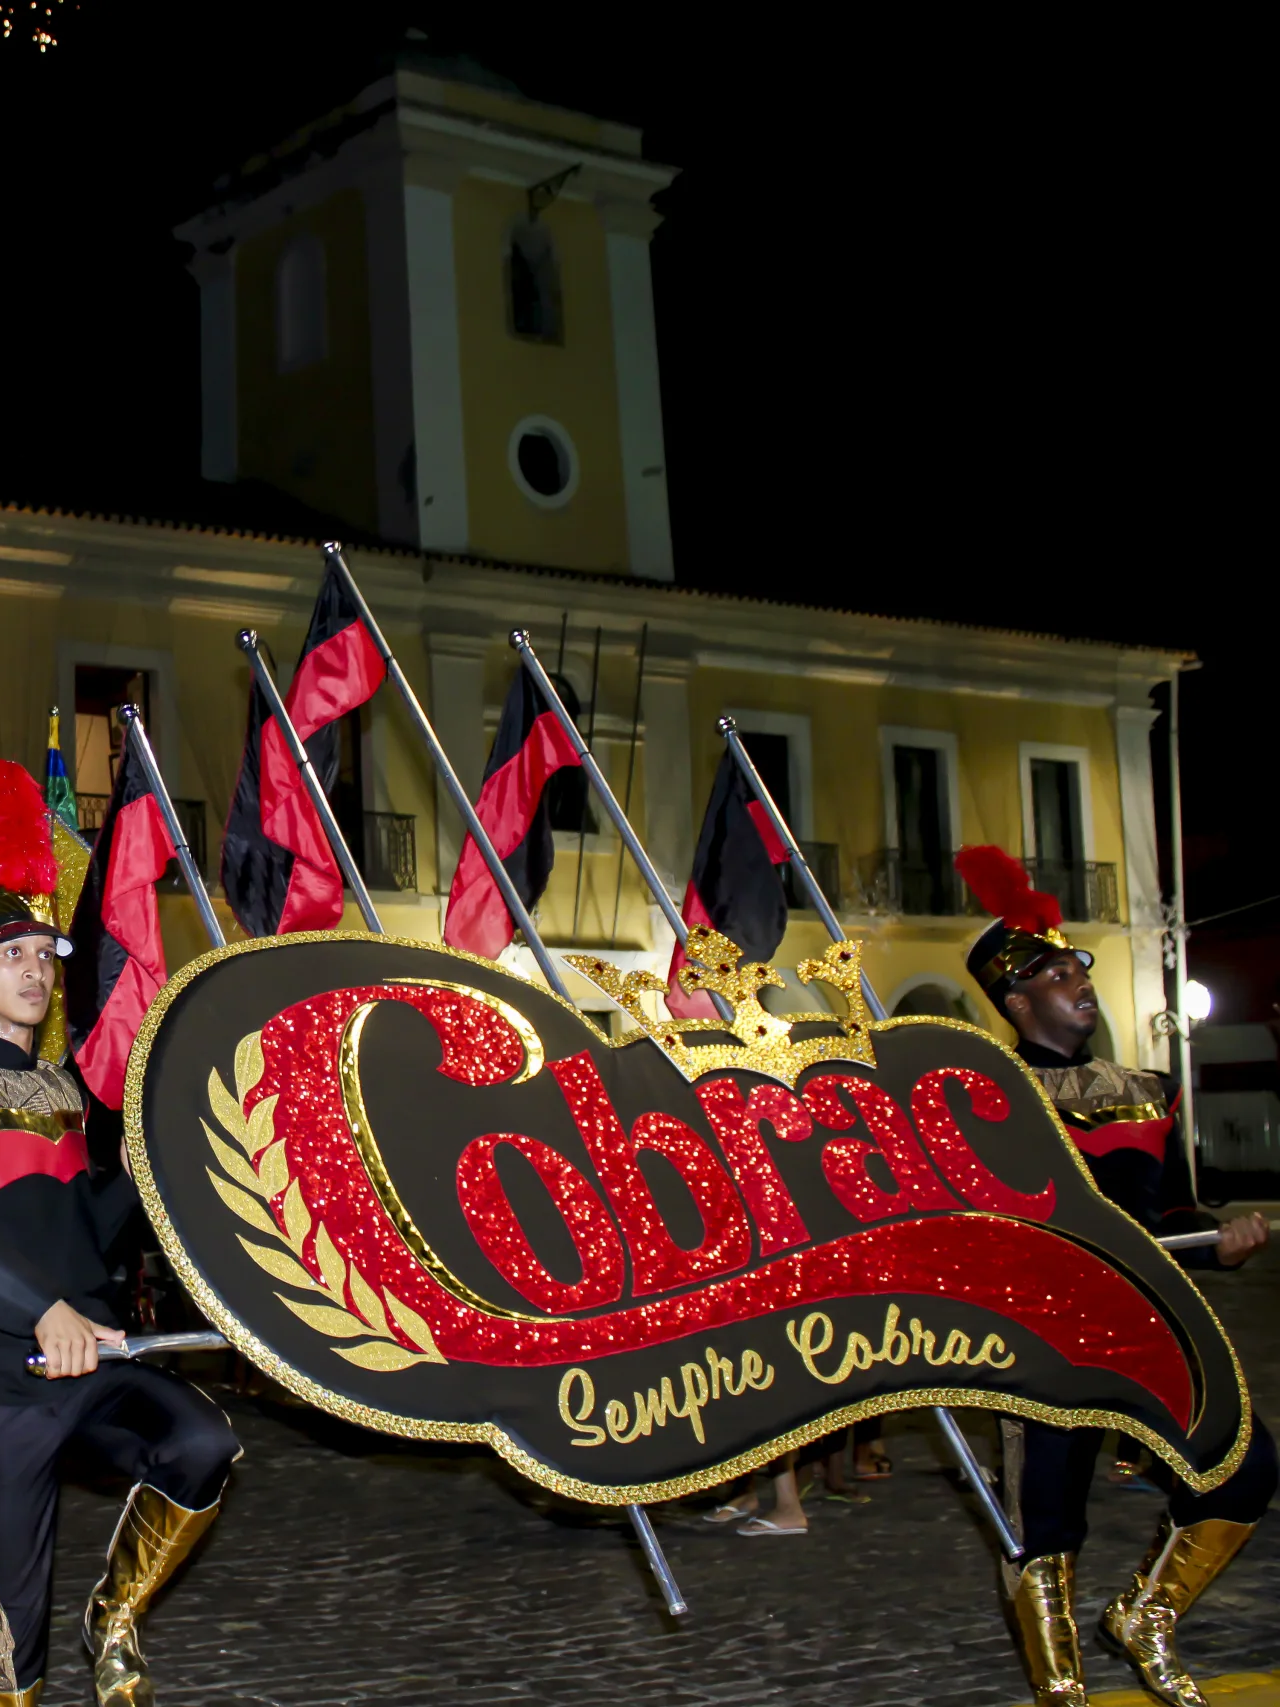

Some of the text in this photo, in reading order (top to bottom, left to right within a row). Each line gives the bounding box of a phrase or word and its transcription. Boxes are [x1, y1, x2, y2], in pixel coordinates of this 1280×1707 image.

[243, 980, 1056, 1368] Cobrac
[558, 1303, 1016, 1447] Sempre Cobrac
